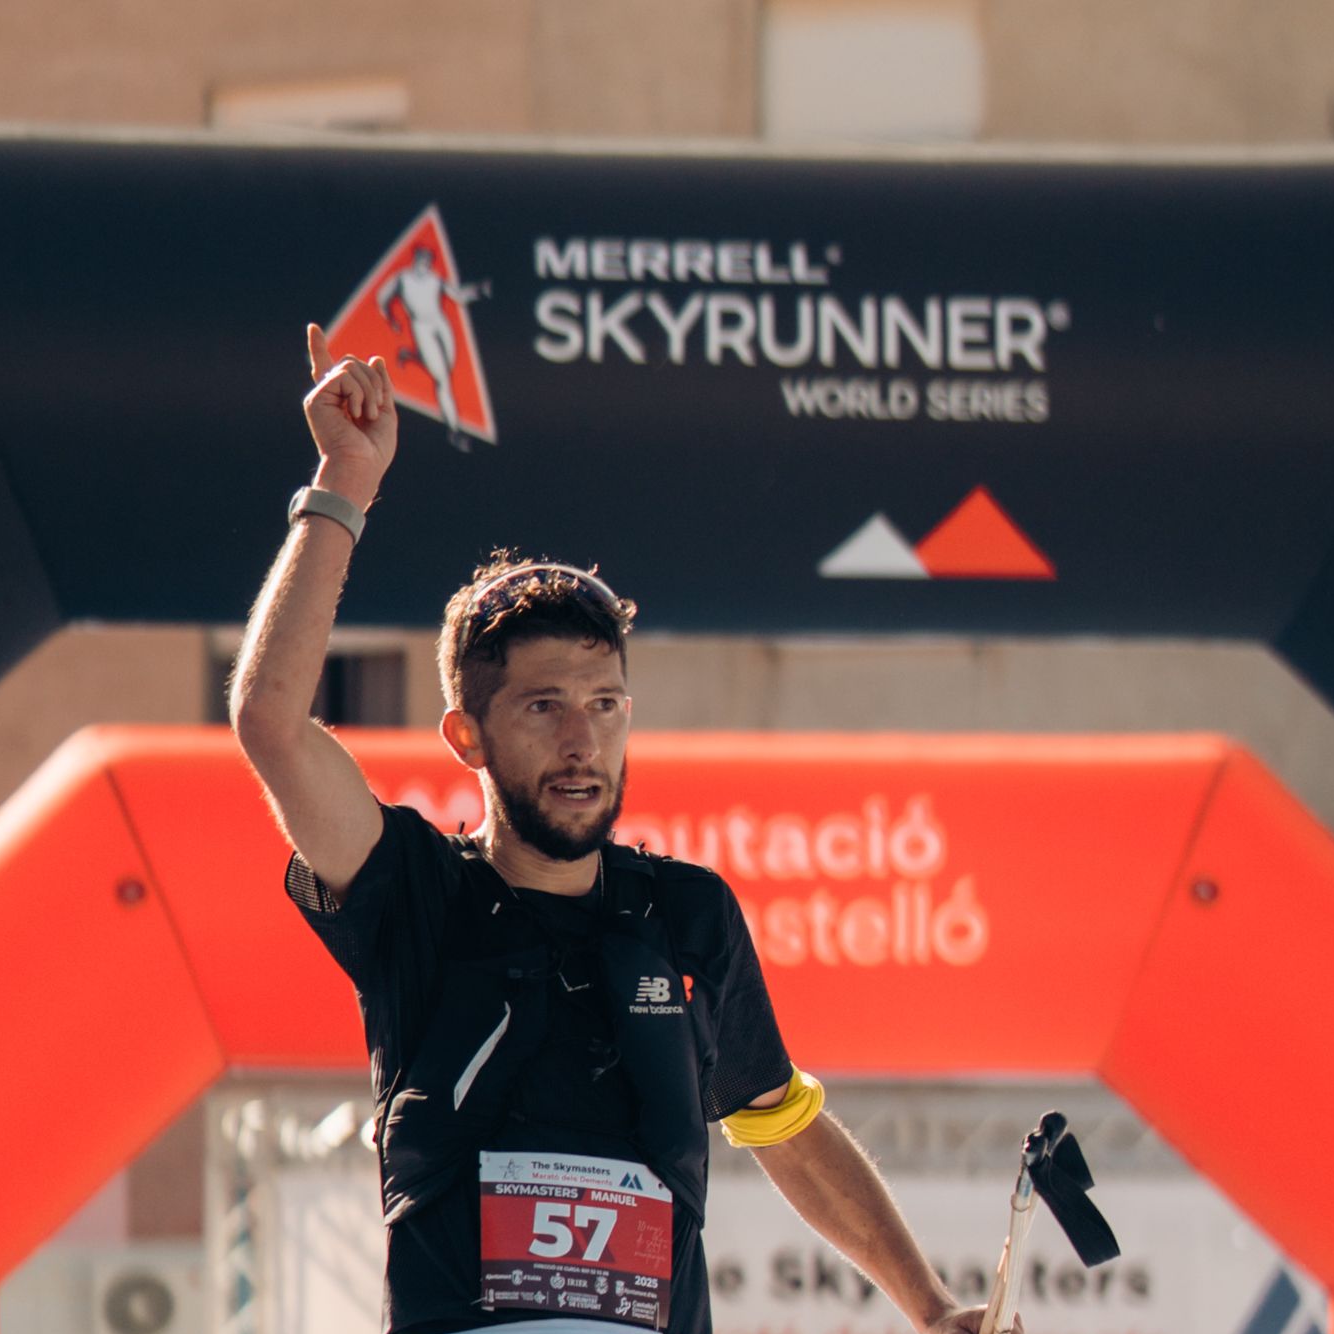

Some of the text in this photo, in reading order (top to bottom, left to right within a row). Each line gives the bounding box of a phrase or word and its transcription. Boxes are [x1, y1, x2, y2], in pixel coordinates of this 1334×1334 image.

[535, 239, 829, 284] MERRELL
[534, 292, 1048, 371] SKYRUNNER
[781, 380, 1050, 422] WORLD SERIES
[747, 874, 990, 967] stelló
[629, 1004, 649, 1014] new
[531, 1160, 611, 1177] The Skymasters
[495, 1183, 638, 1208] SKYMASTERS MANUEL
[528, 1201, 618, 1262] 57
[634, 1275, 659, 1289] 2025
